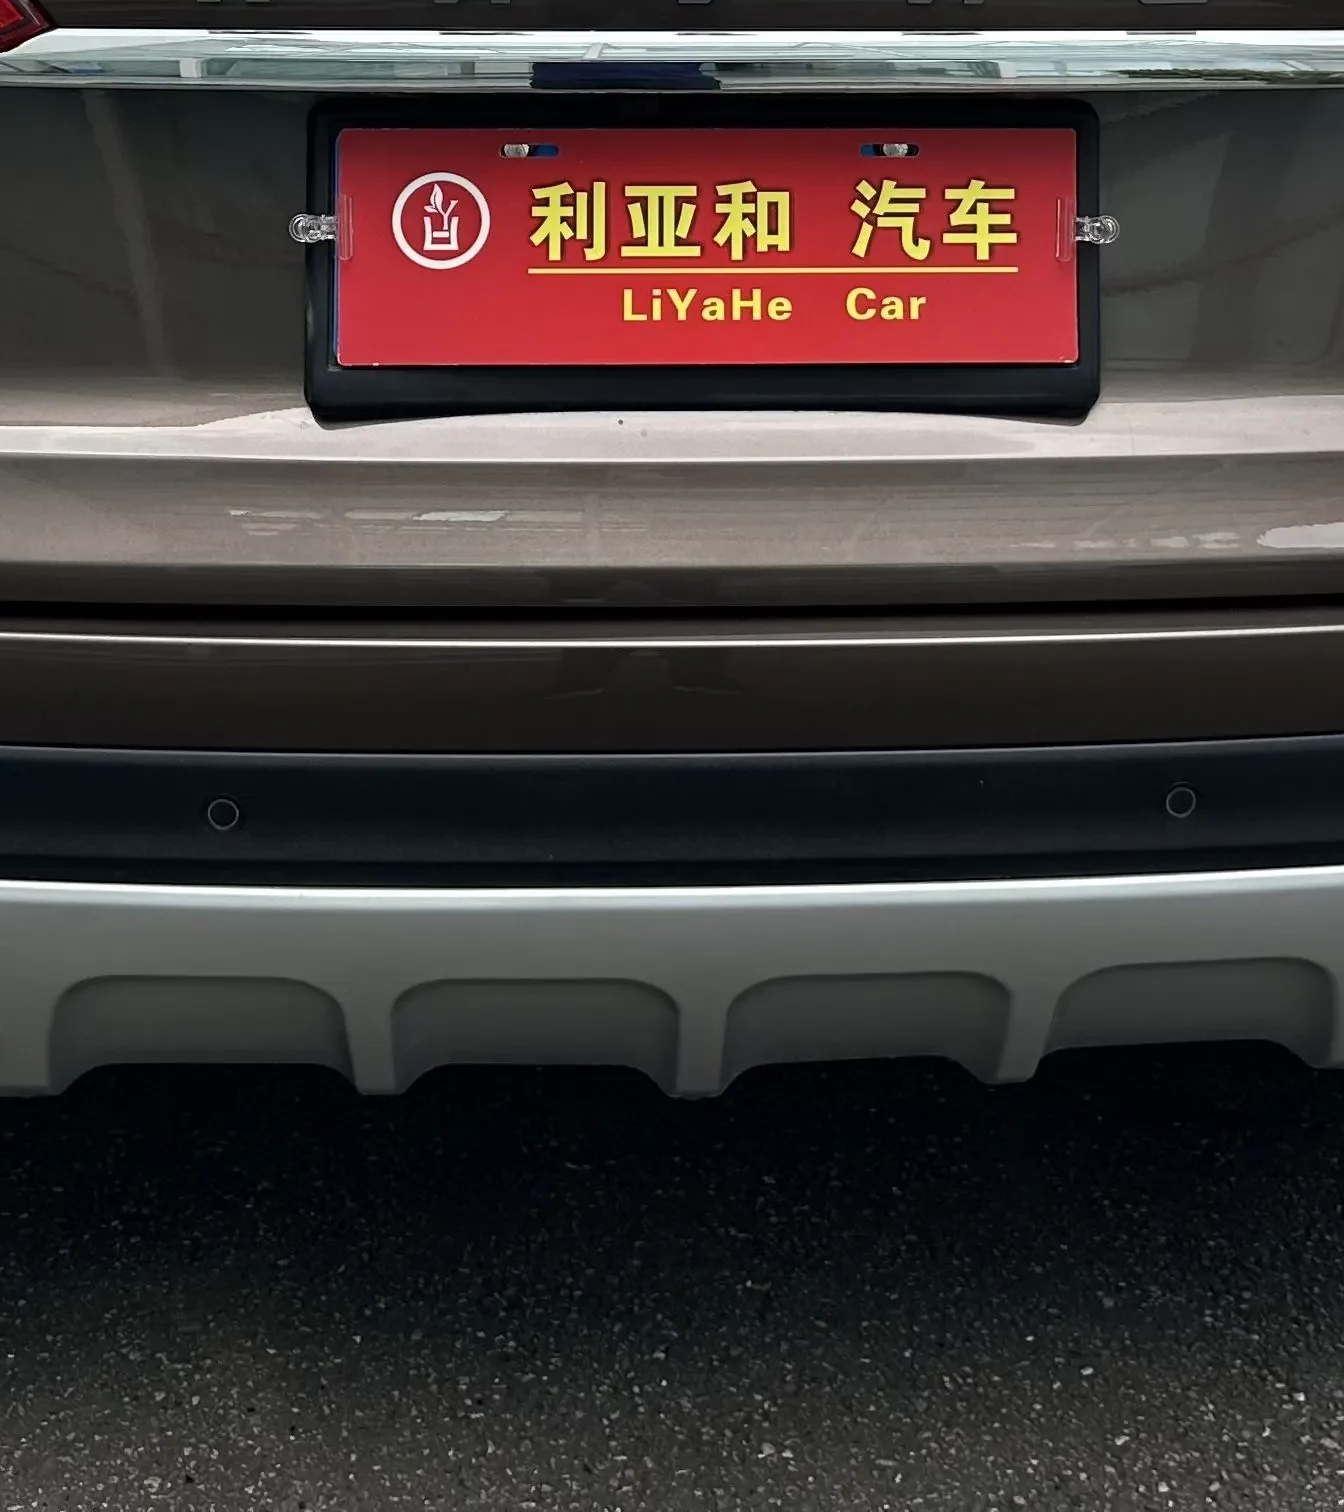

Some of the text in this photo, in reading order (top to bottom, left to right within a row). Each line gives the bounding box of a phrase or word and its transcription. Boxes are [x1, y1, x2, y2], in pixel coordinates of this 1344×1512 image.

[529, 179, 1018, 261] 利亚和 汽车
[623, 287, 927, 321] LiYaHe Car
